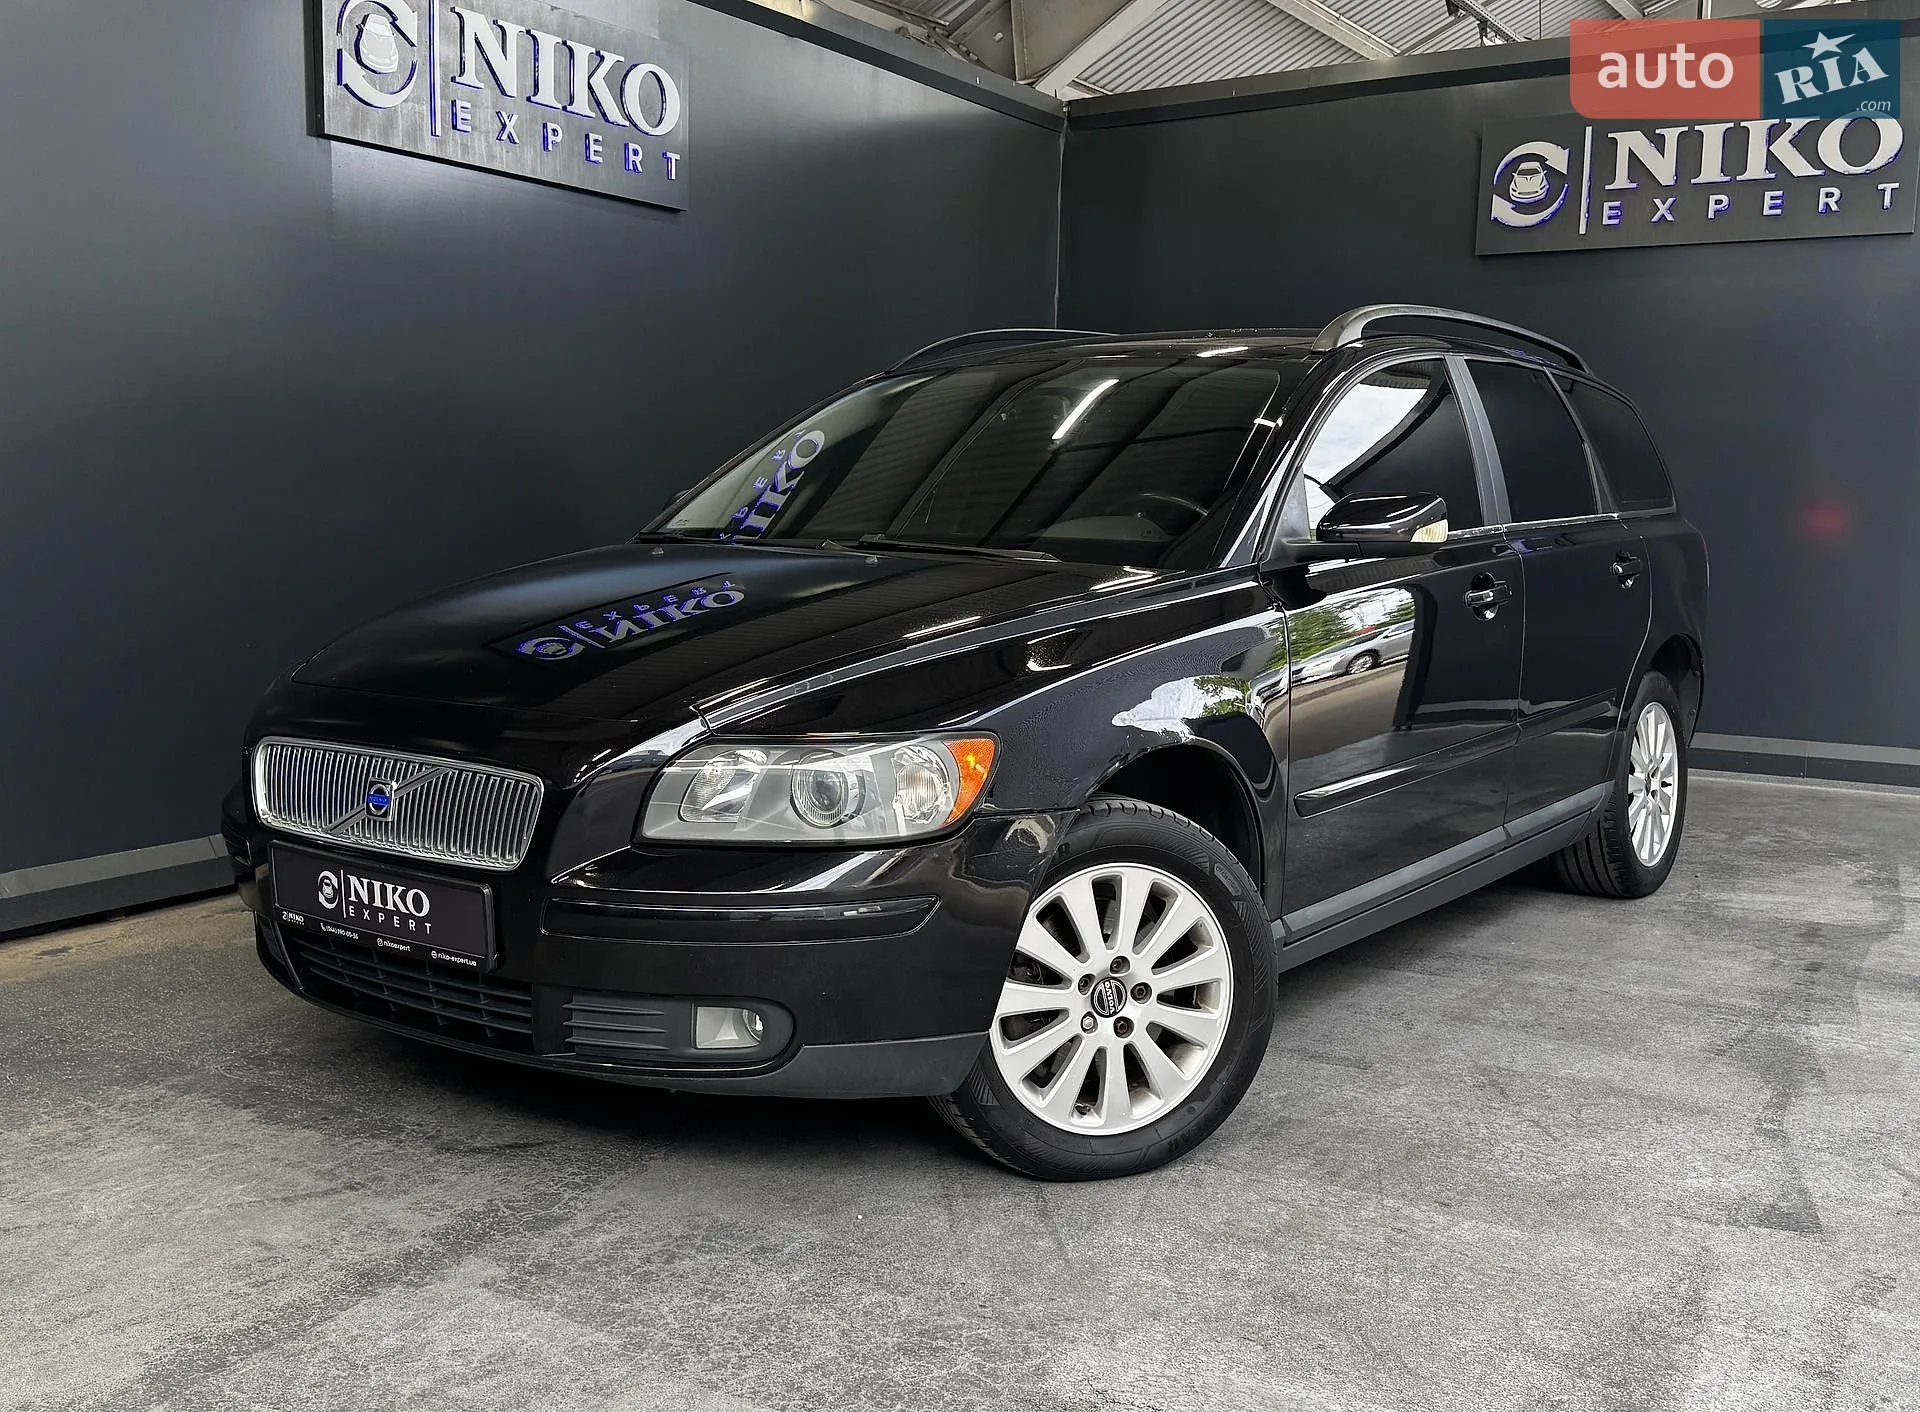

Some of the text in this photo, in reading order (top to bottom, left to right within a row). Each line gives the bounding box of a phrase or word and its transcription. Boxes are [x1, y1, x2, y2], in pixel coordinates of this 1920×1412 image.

[450, 6, 681, 136] NIKO
[451, 99, 681, 180] EXPERT
[1604, 110, 1904, 190] NIKO
[1602, 183, 1900, 225] EXPERT
[346, 874, 430, 917] NIKO
[349, 905, 432, 935] EXPERT
[1104, 981, 1116, 1014] VOLVO
